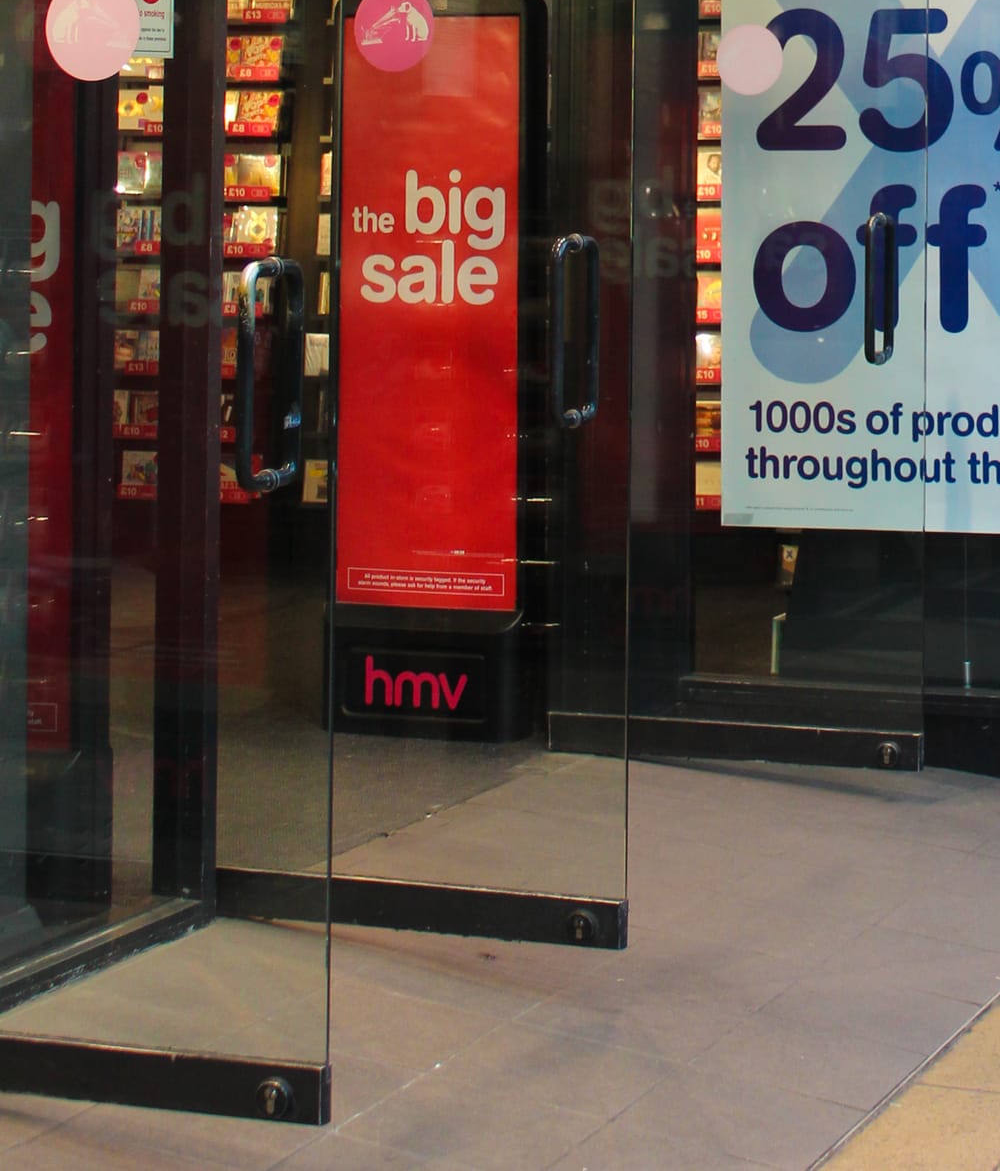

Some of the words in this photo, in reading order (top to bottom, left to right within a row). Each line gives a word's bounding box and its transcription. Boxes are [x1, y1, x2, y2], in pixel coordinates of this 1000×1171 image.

[144, 9, 165, 20] smoking
[245, 10, 262, 19] £13
[147, 124, 163, 133] £10
[228, 188, 245, 197] £10
[352, 205, 395, 233] the
[405, 169, 506, 250] big
[227, 245, 243, 254] £10
[360, 239, 499, 305] sale
[130, 302, 147, 311] £10
[696, 310, 708, 319] 15
[749, 400, 857, 435] 1000s
[866, 402, 903, 437] of
[696, 439, 710, 448] 10
[745, 446, 956, 489] throughout
[364, 654, 468, 711] hmv
